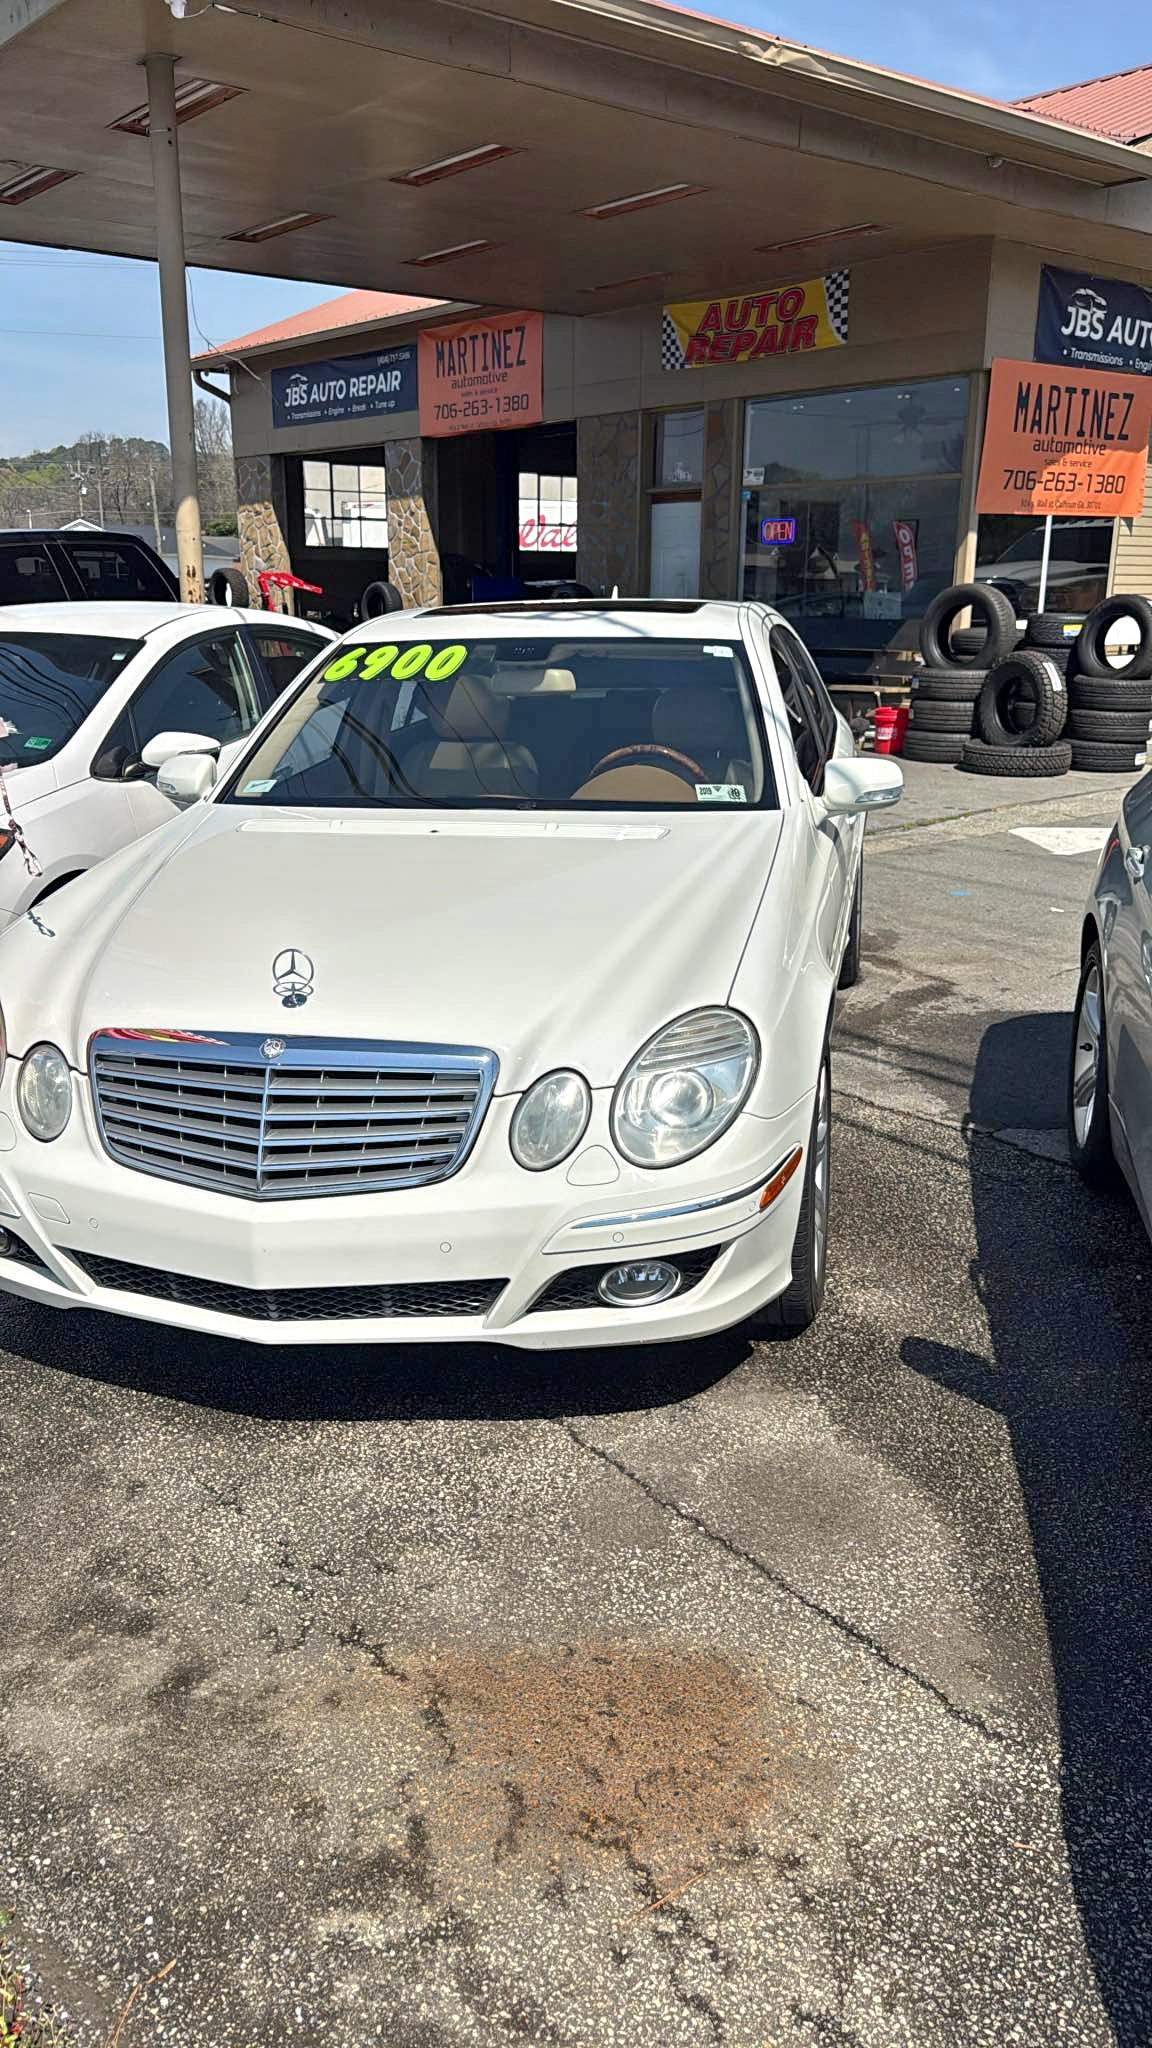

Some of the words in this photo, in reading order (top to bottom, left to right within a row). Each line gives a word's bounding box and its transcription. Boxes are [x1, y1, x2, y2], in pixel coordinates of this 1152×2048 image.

[696, 288, 806, 333] AUTO
[684, 315, 819, 365] REPAIR
[1106, 315, 1152, 348] AUT
[435, 326, 527, 378] MARTINEZ
[1071, 348, 1123, 366] Transmissions
[310, 380, 346, 403] AUTO
[349, 371, 401, 398] REPAIR
[451, 371, 508, 390] automotive
[434, 394, 529, 420] 706-263-1380
[1013, 381, 1135, 441] MARTINEZ
[1032, 439, 1107, 456] automotive
[1003, 469, 1126, 494] 706-263-1380
[764, 521, 793, 541] OPEN
[323, 644, 468, 682] 6900
